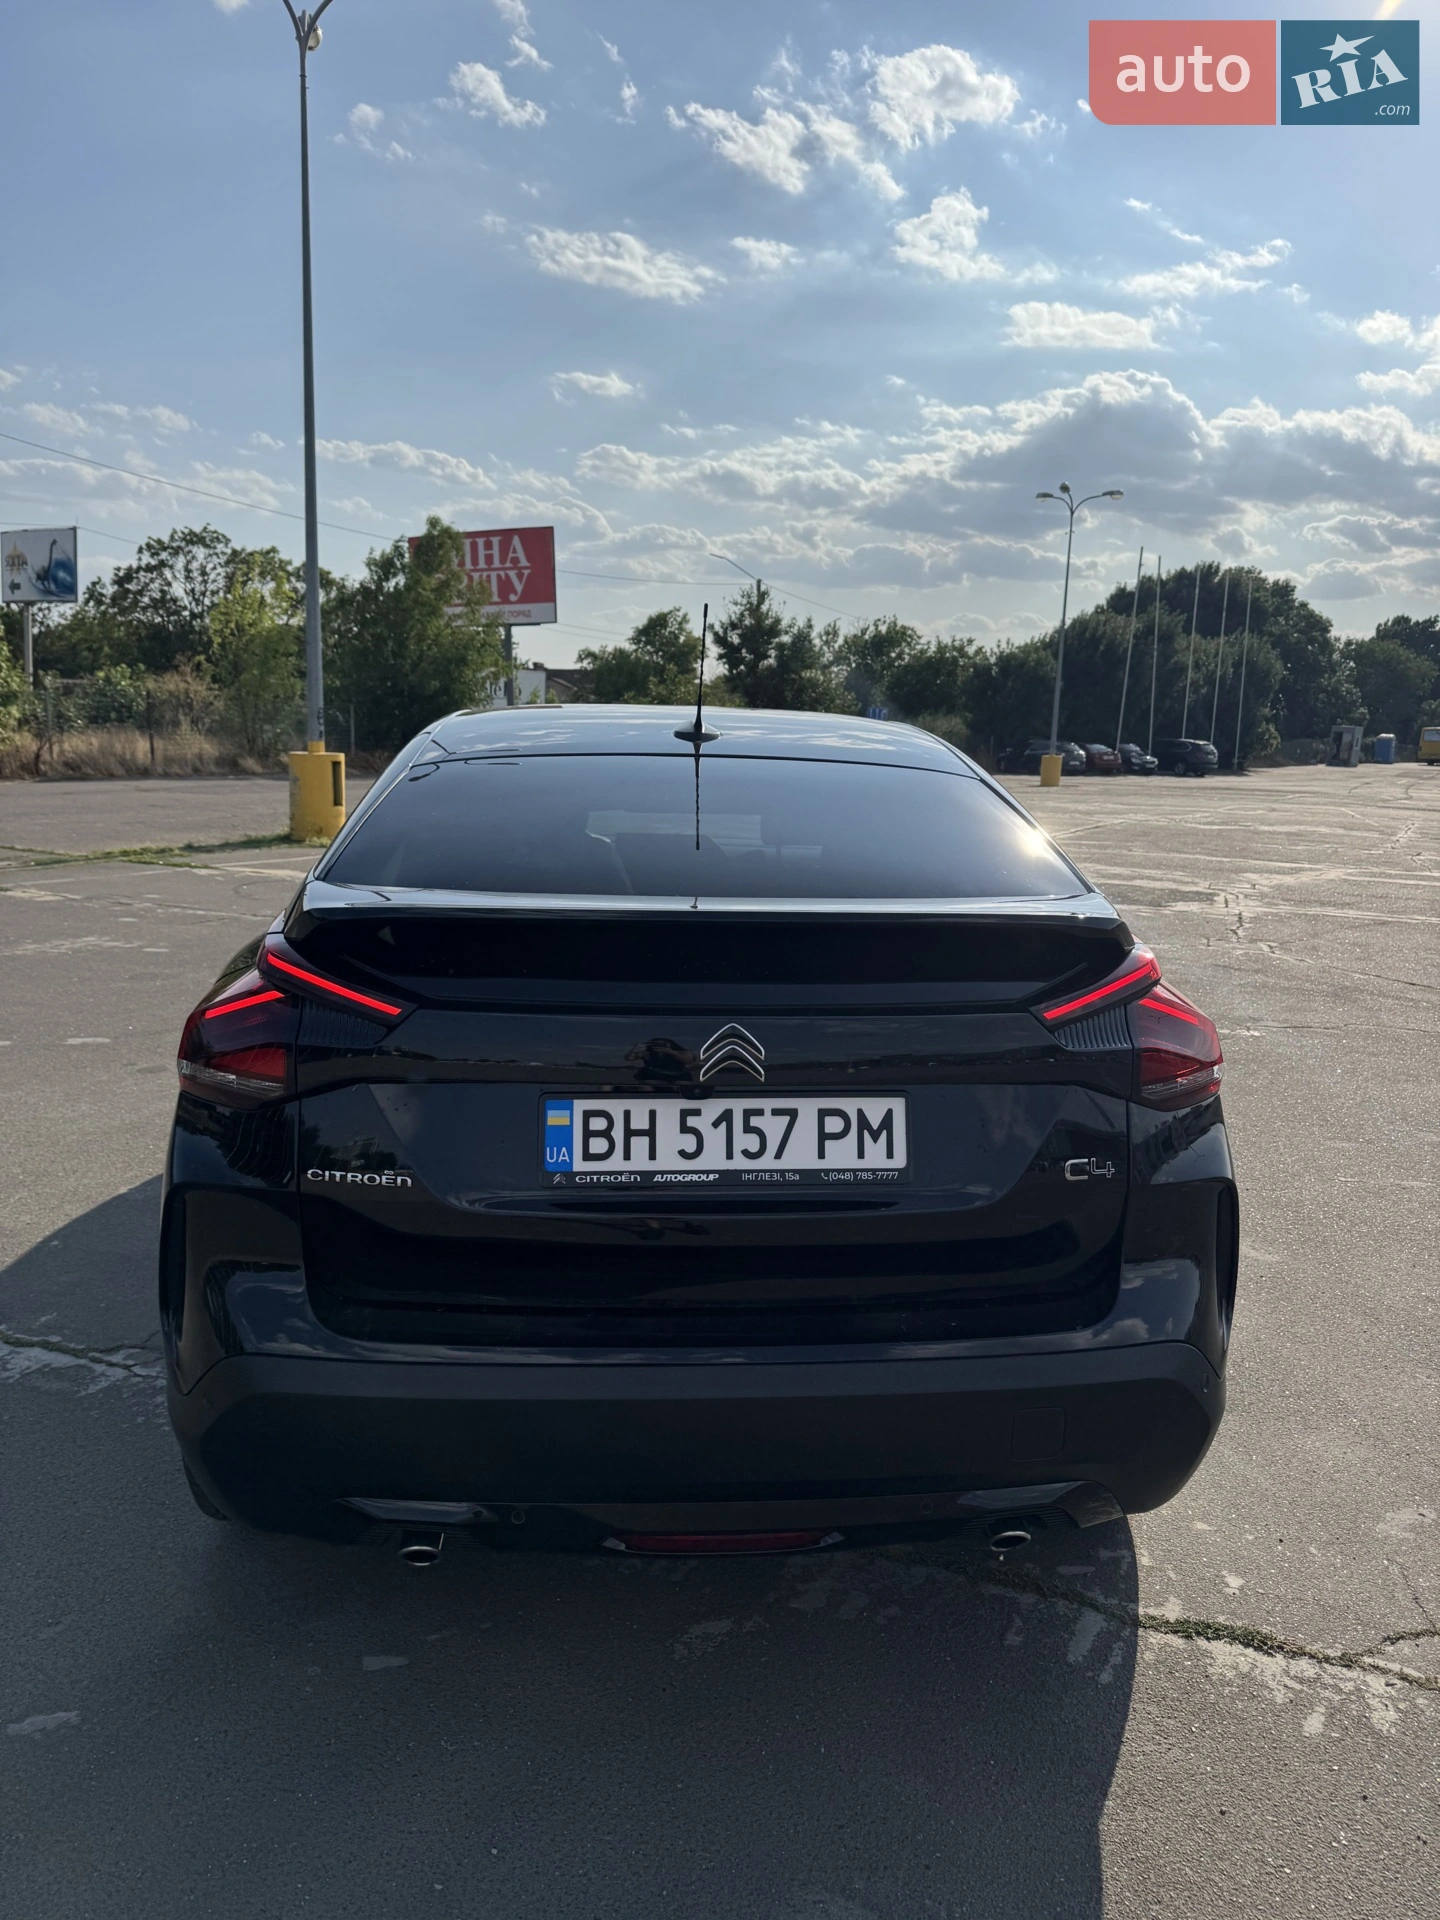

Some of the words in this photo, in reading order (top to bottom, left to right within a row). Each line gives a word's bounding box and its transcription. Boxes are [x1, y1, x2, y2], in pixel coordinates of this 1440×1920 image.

[582, 1109, 657, 1162] BH
[677, 1108, 799, 1161] 5157
[817, 1108, 894, 1160] PM
[546, 1147, 570, 1163] UA
[1065, 1157, 1115, 1181] C4
[653, 1173, 719, 1182] AUTOGROUP
[741, 1172, 783, 1182] ІНГЛЕЗІ,
[829, 1171, 854, 1182] (048)
[856, 1171, 899, 1180] 785-7777
